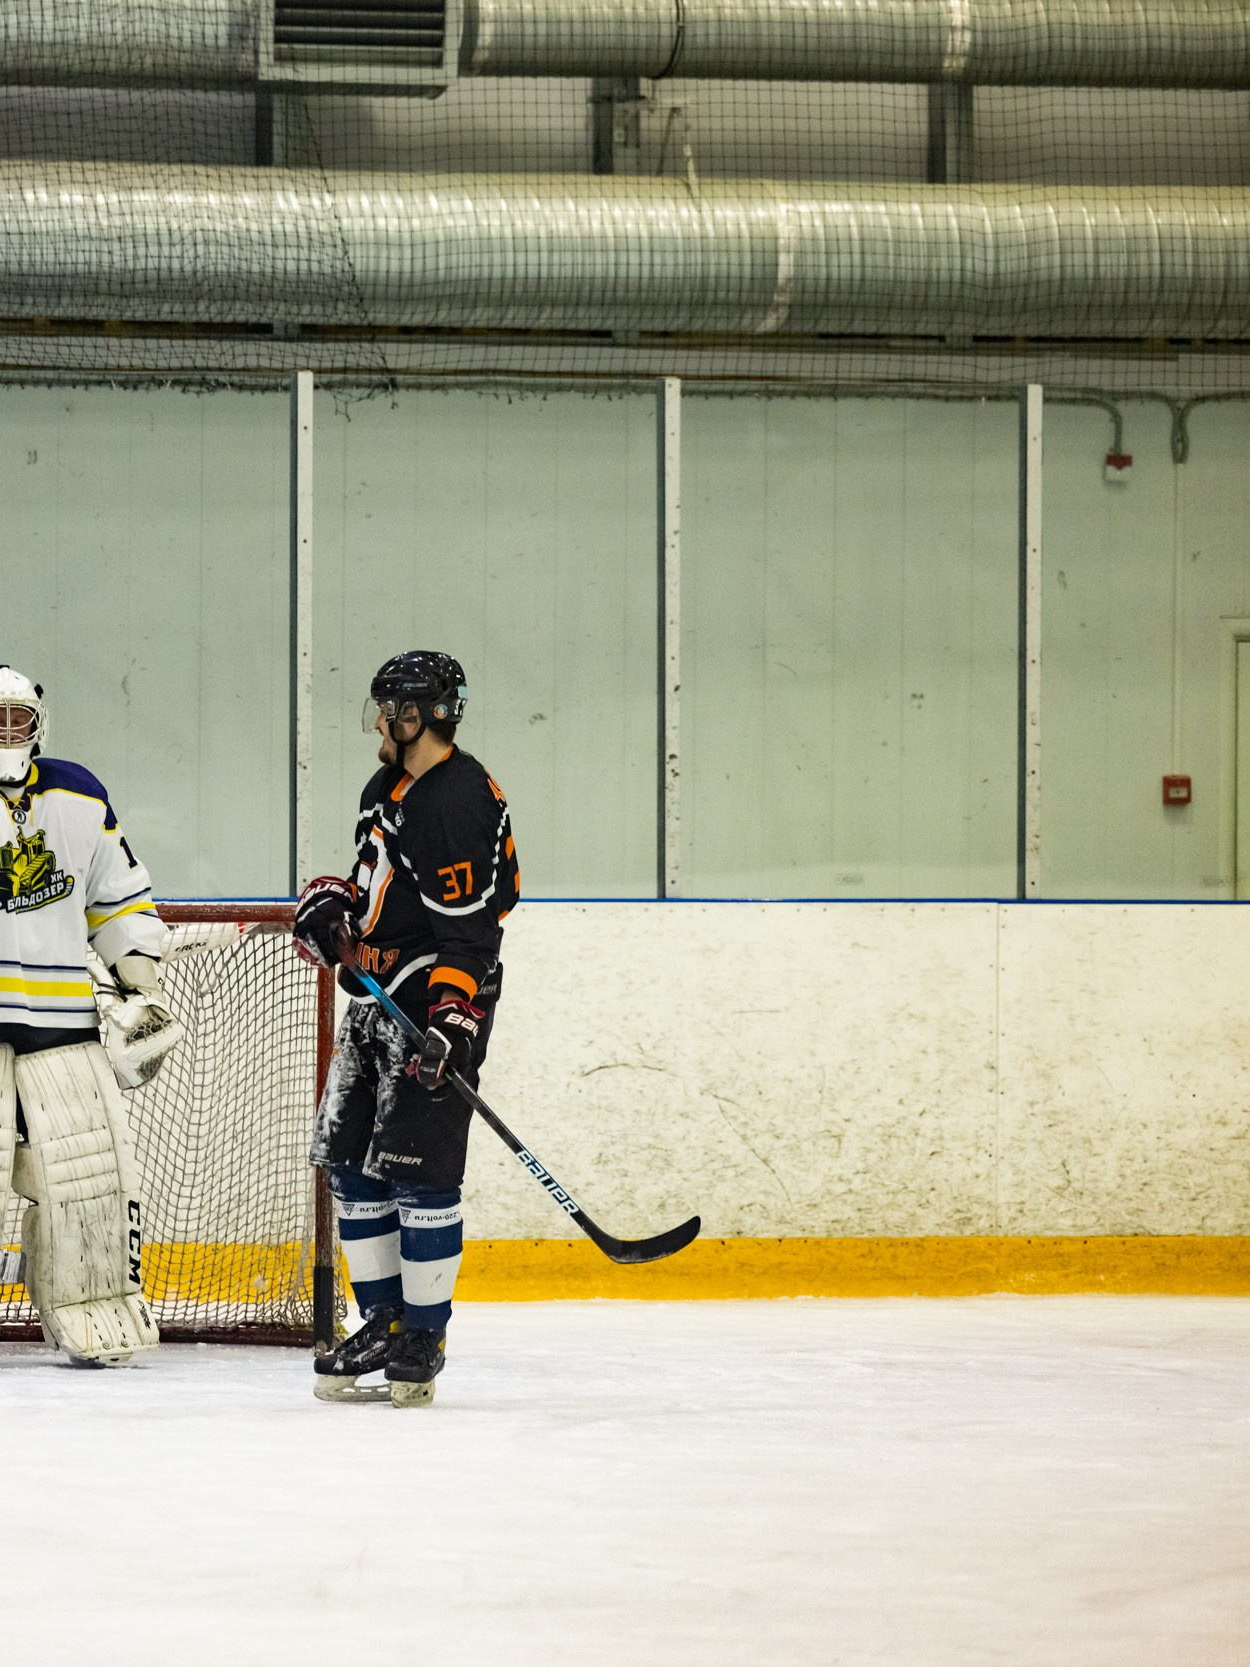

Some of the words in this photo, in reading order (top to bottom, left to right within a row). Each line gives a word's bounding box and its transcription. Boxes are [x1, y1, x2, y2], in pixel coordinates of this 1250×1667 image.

[120, 836, 138, 868] 1
[7, 881, 65, 911] БЛЬДОЗЕР
[437, 861, 473, 901] 37
[128, 1199, 141, 1285] CCM
